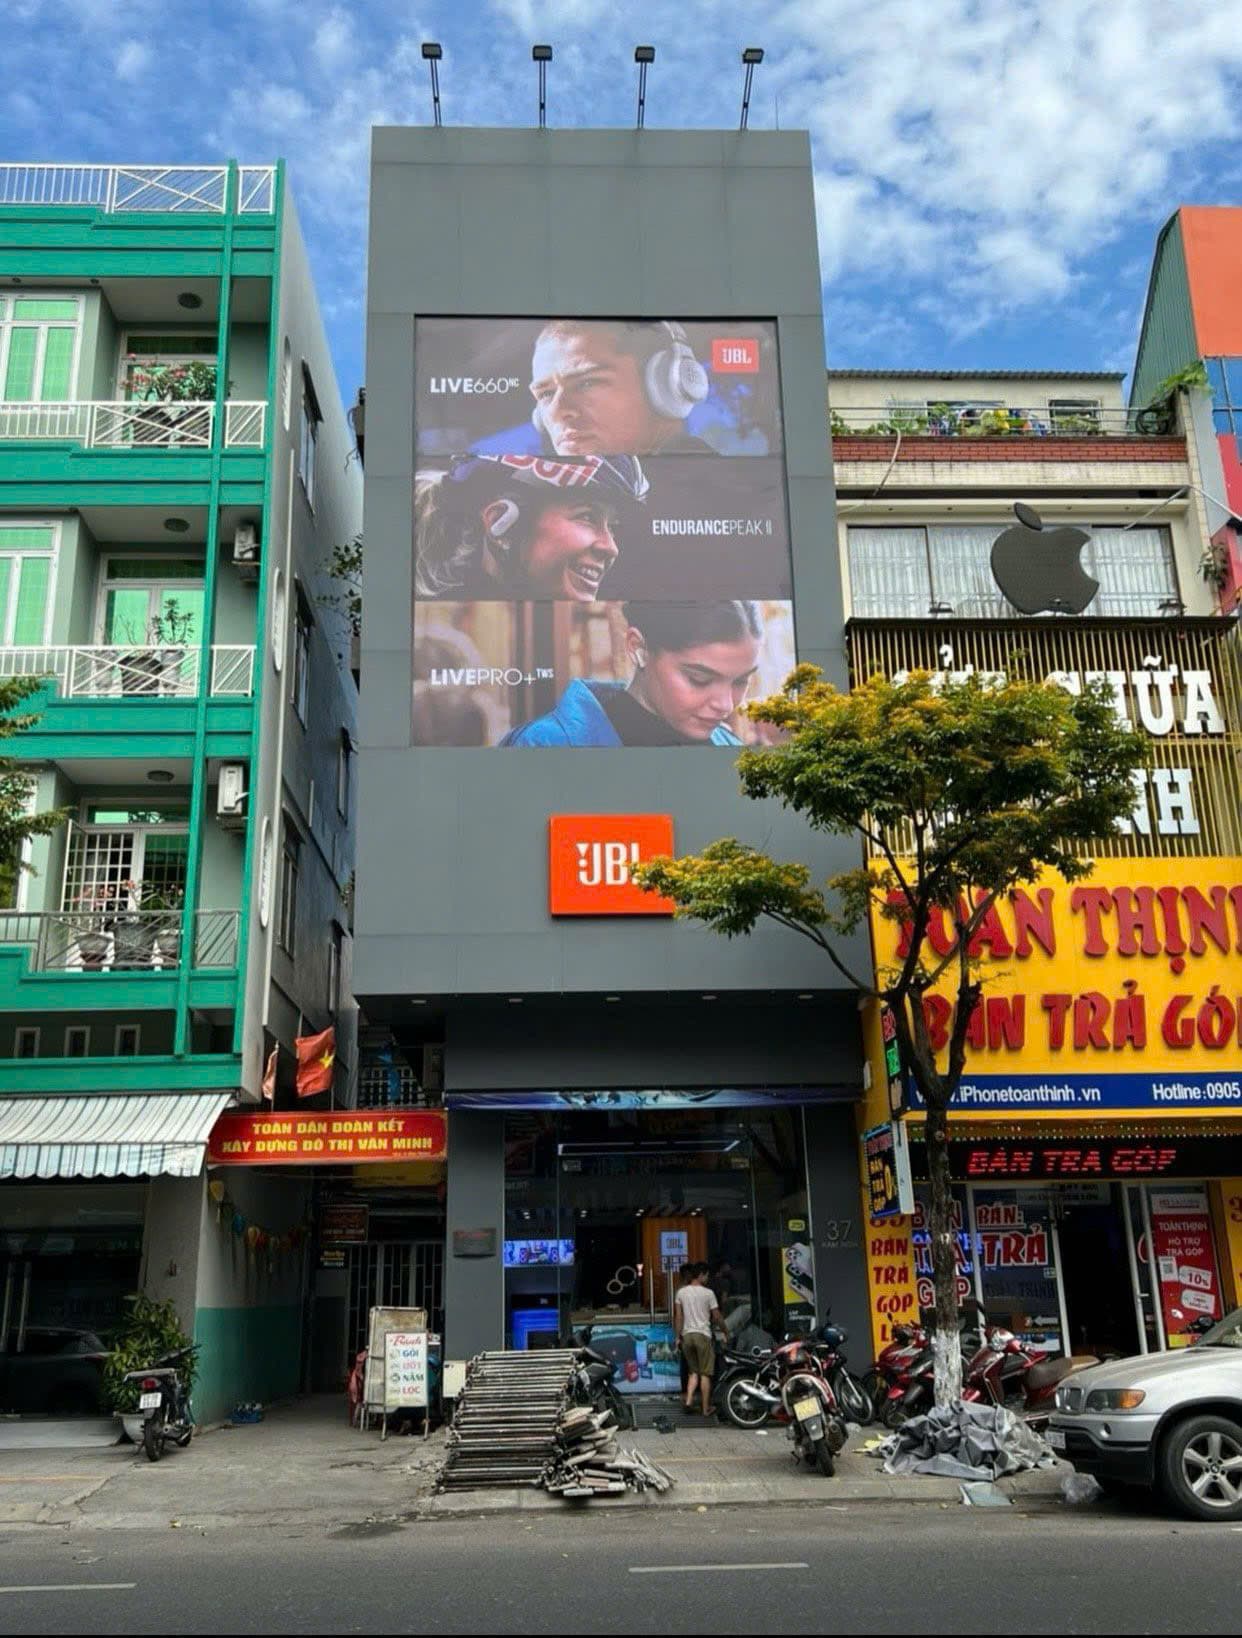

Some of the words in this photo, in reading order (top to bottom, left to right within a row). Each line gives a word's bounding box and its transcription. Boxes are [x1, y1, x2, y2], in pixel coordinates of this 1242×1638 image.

[1041, 979, 1148, 1050] TRẢ
[1161, 984, 1242, 1050] GÓ
[392, 1137, 433, 1149] MINH
[827, 1220, 851, 1241] 37
[982, 1223, 1049, 1267] TRẢ
